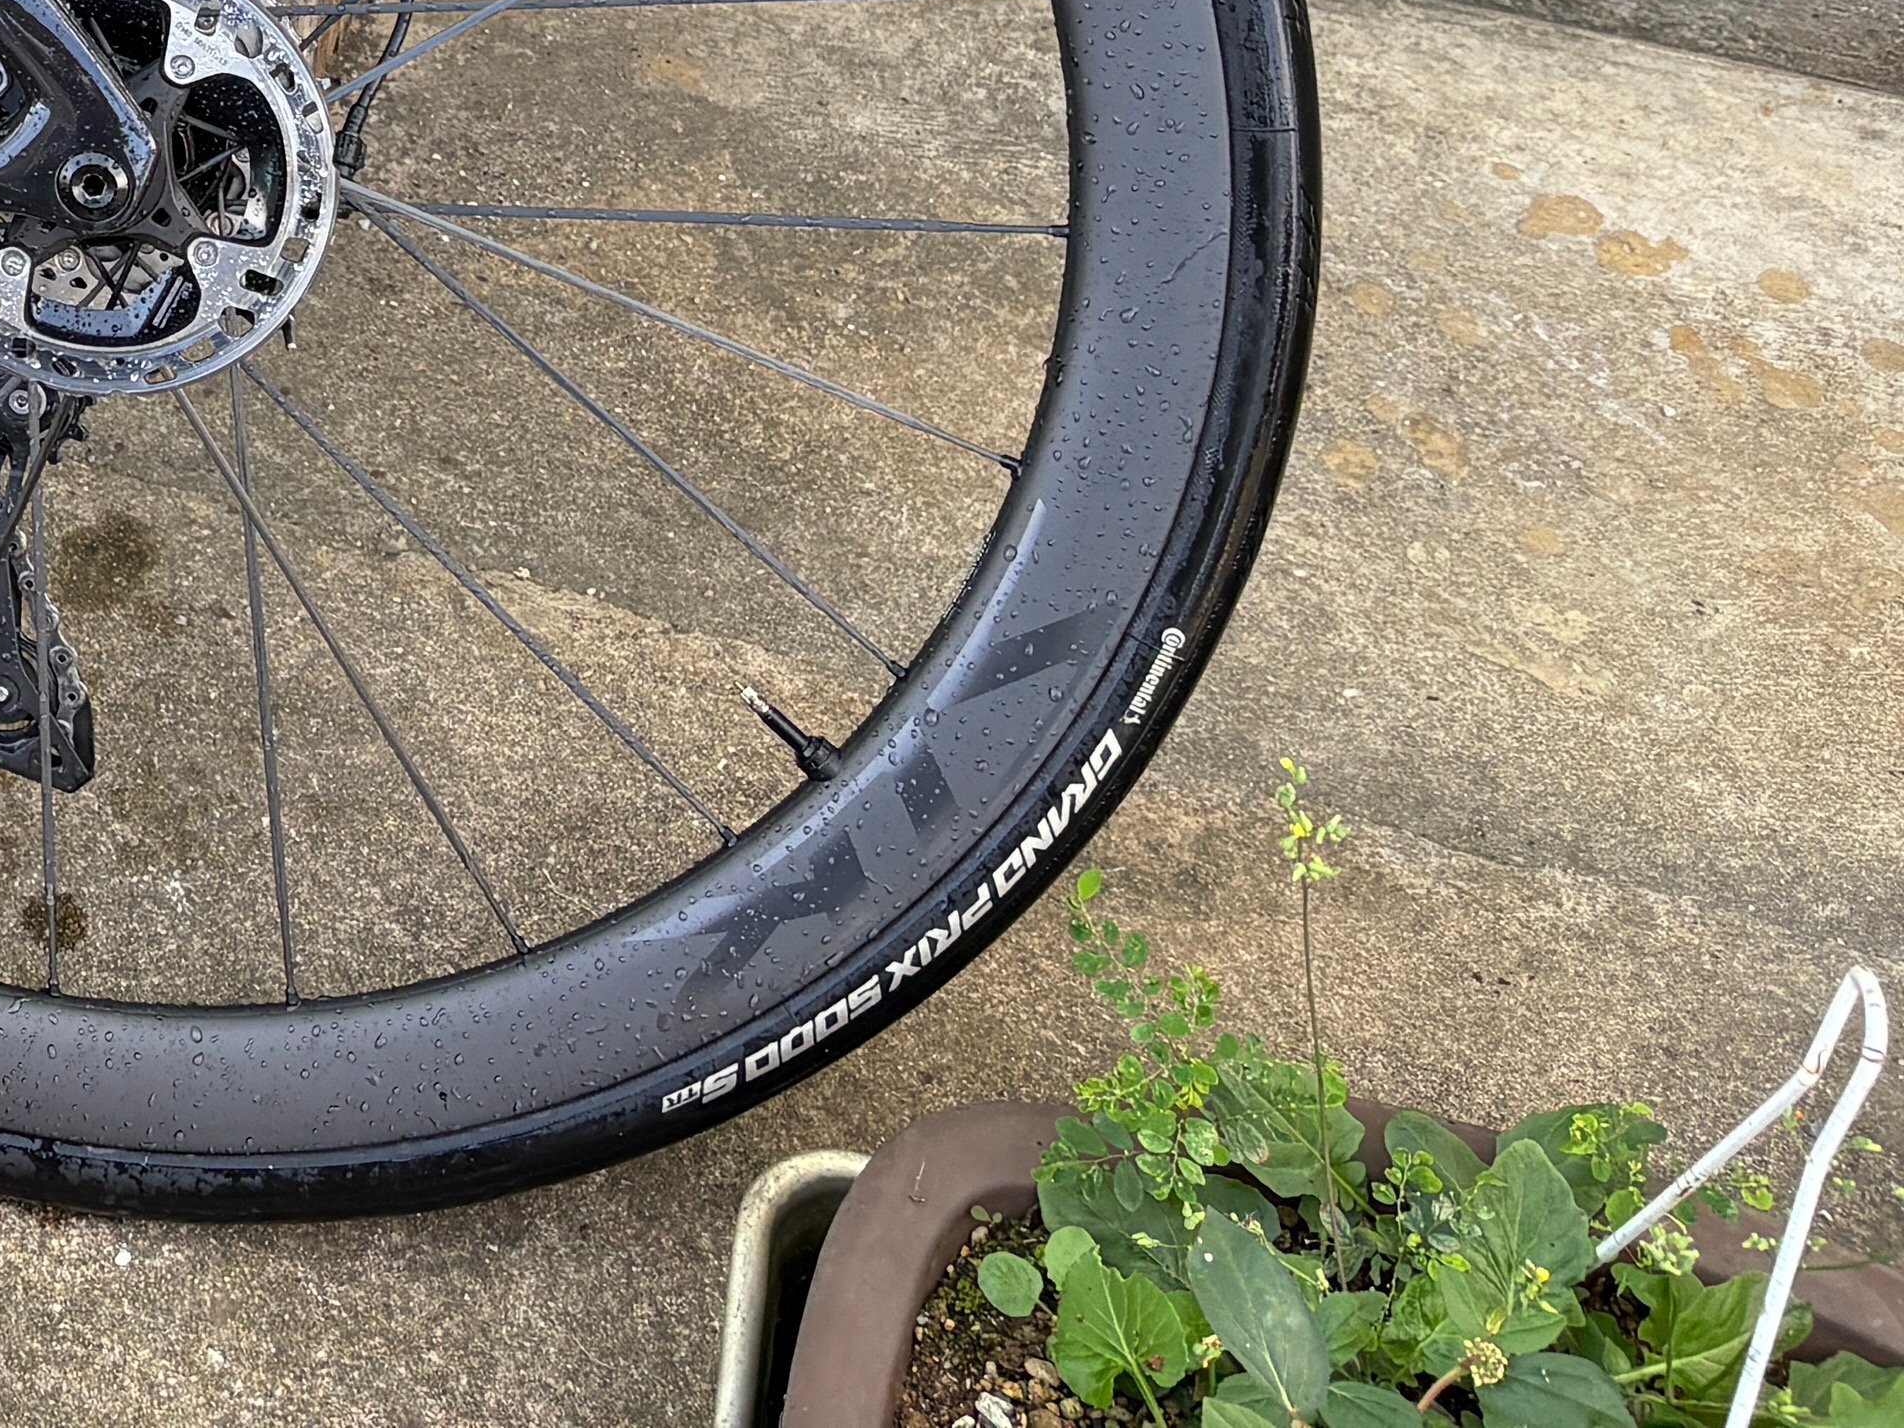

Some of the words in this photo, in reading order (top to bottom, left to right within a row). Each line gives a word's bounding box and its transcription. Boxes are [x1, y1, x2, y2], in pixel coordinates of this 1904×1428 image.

[1128, 627, 1186, 715] Continental
[993, 728, 1122, 898] GRAND
[885, 882, 993, 992] PRIX
[744, 974, 882, 1082] 5000
